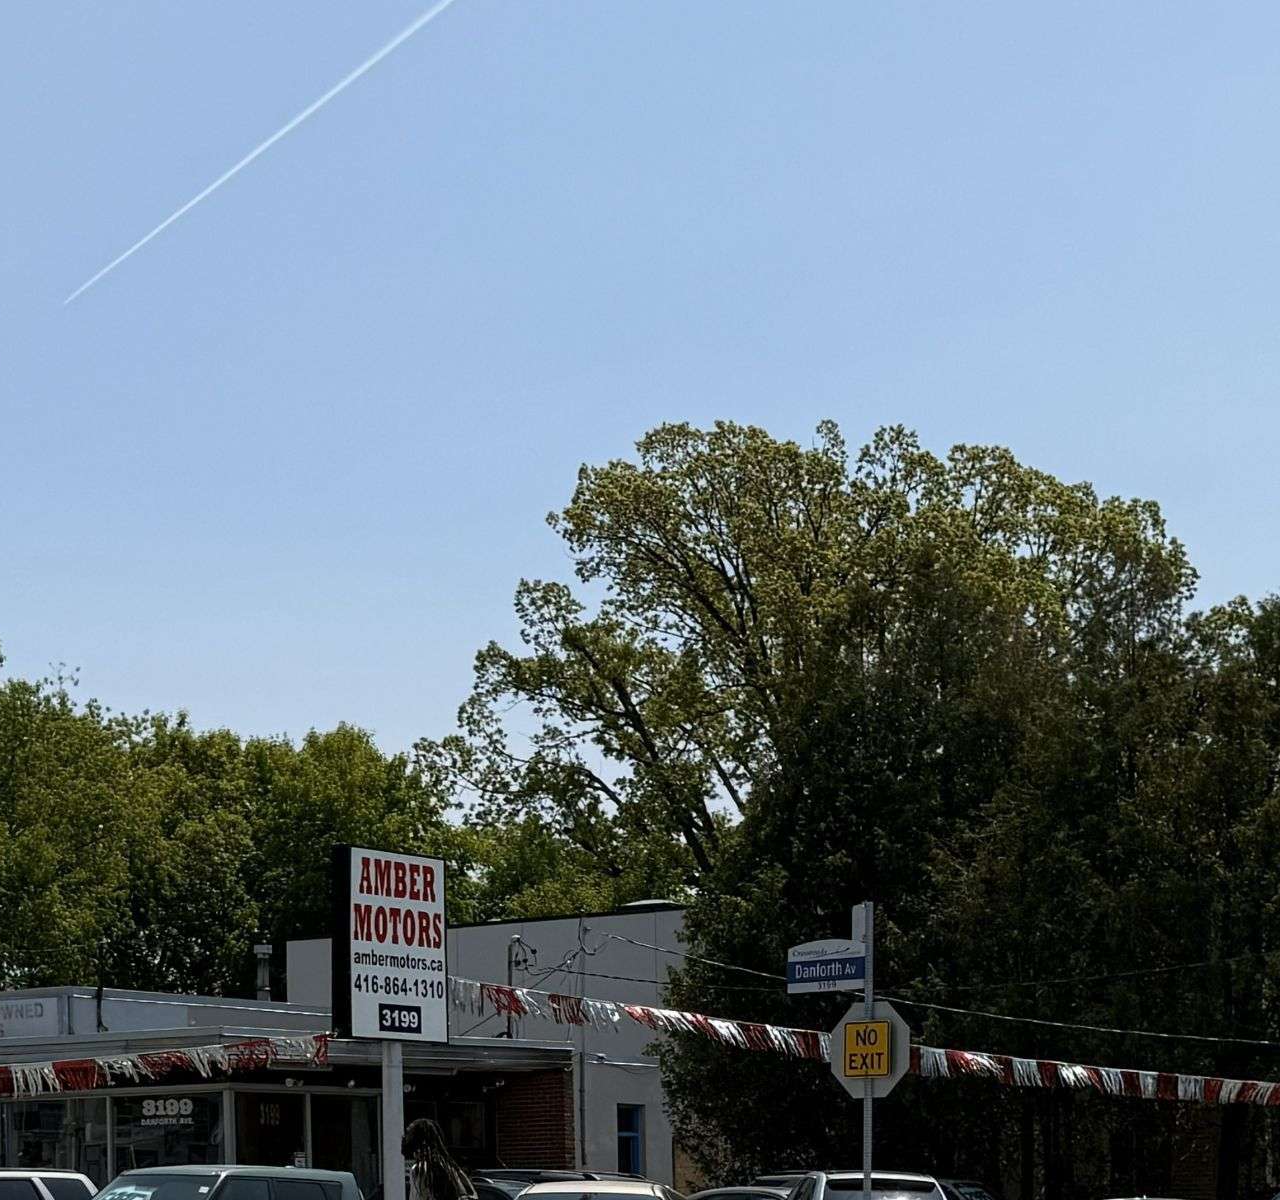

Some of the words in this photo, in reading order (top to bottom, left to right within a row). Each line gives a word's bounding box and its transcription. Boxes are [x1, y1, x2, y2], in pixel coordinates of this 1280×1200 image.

[359, 856, 436, 903] AMBER
[353, 903, 442, 949] MOTORS
[353, 948, 443, 972] ambermotors.ca
[795, 961, 842, 979] Danforth
[844, 963, 857, 975] Av
[354, 974, 444, 999] 416-864-1310
[382, 1009, 419, 1028] 3199
[856, 1028, 878, 1046] NO
[849, 1052, 884, 1070] EXIT
[142, 1099, 193, 1115] 3199
